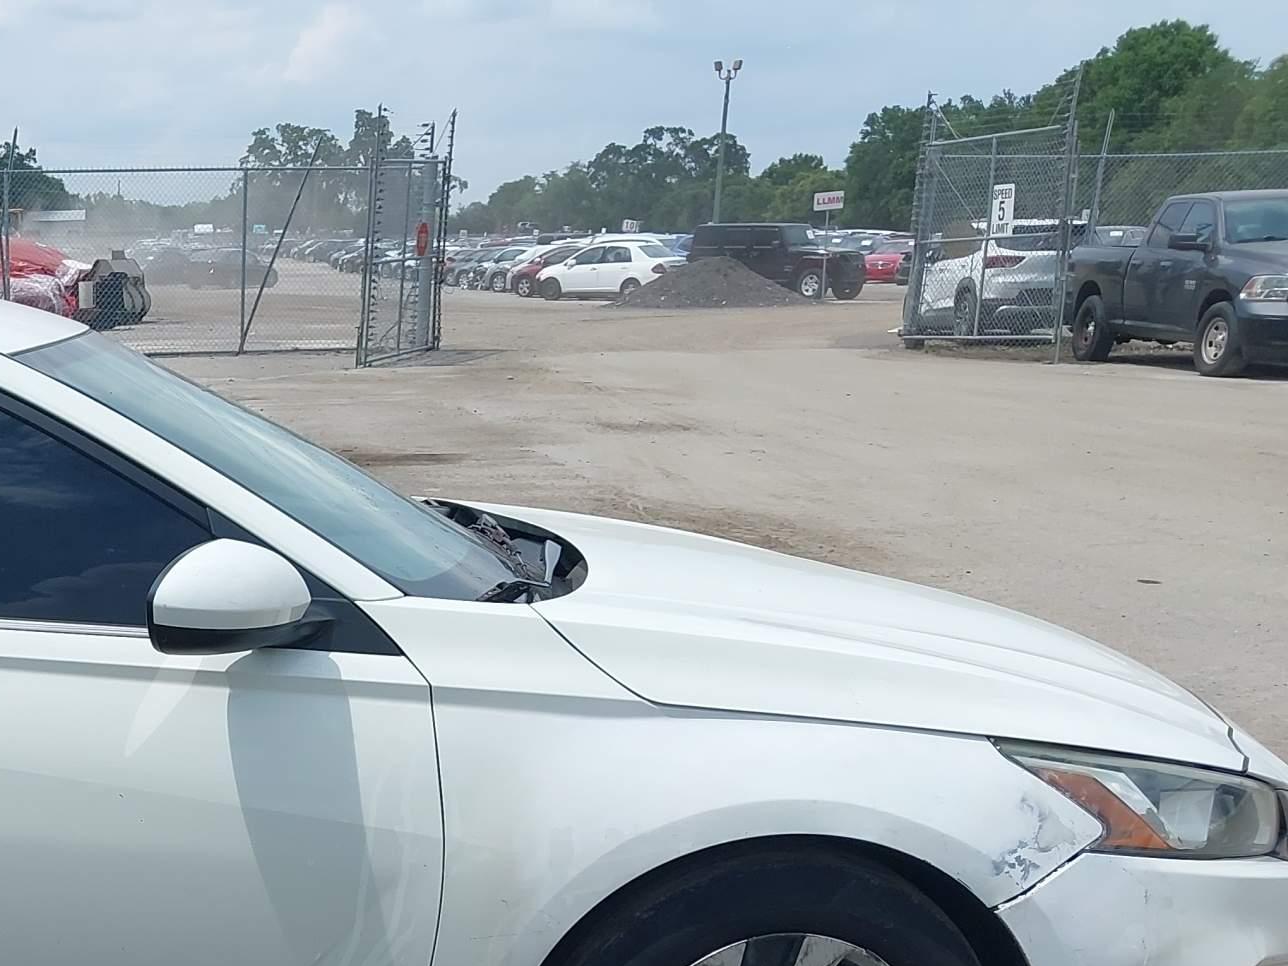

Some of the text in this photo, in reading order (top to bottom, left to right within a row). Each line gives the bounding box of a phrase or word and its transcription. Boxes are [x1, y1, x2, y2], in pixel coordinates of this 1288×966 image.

[993, 188, 1013, 200] SPEED
[998, 200, 1005, 221] 5
[992, 222, 1010, 235] LIMIT
